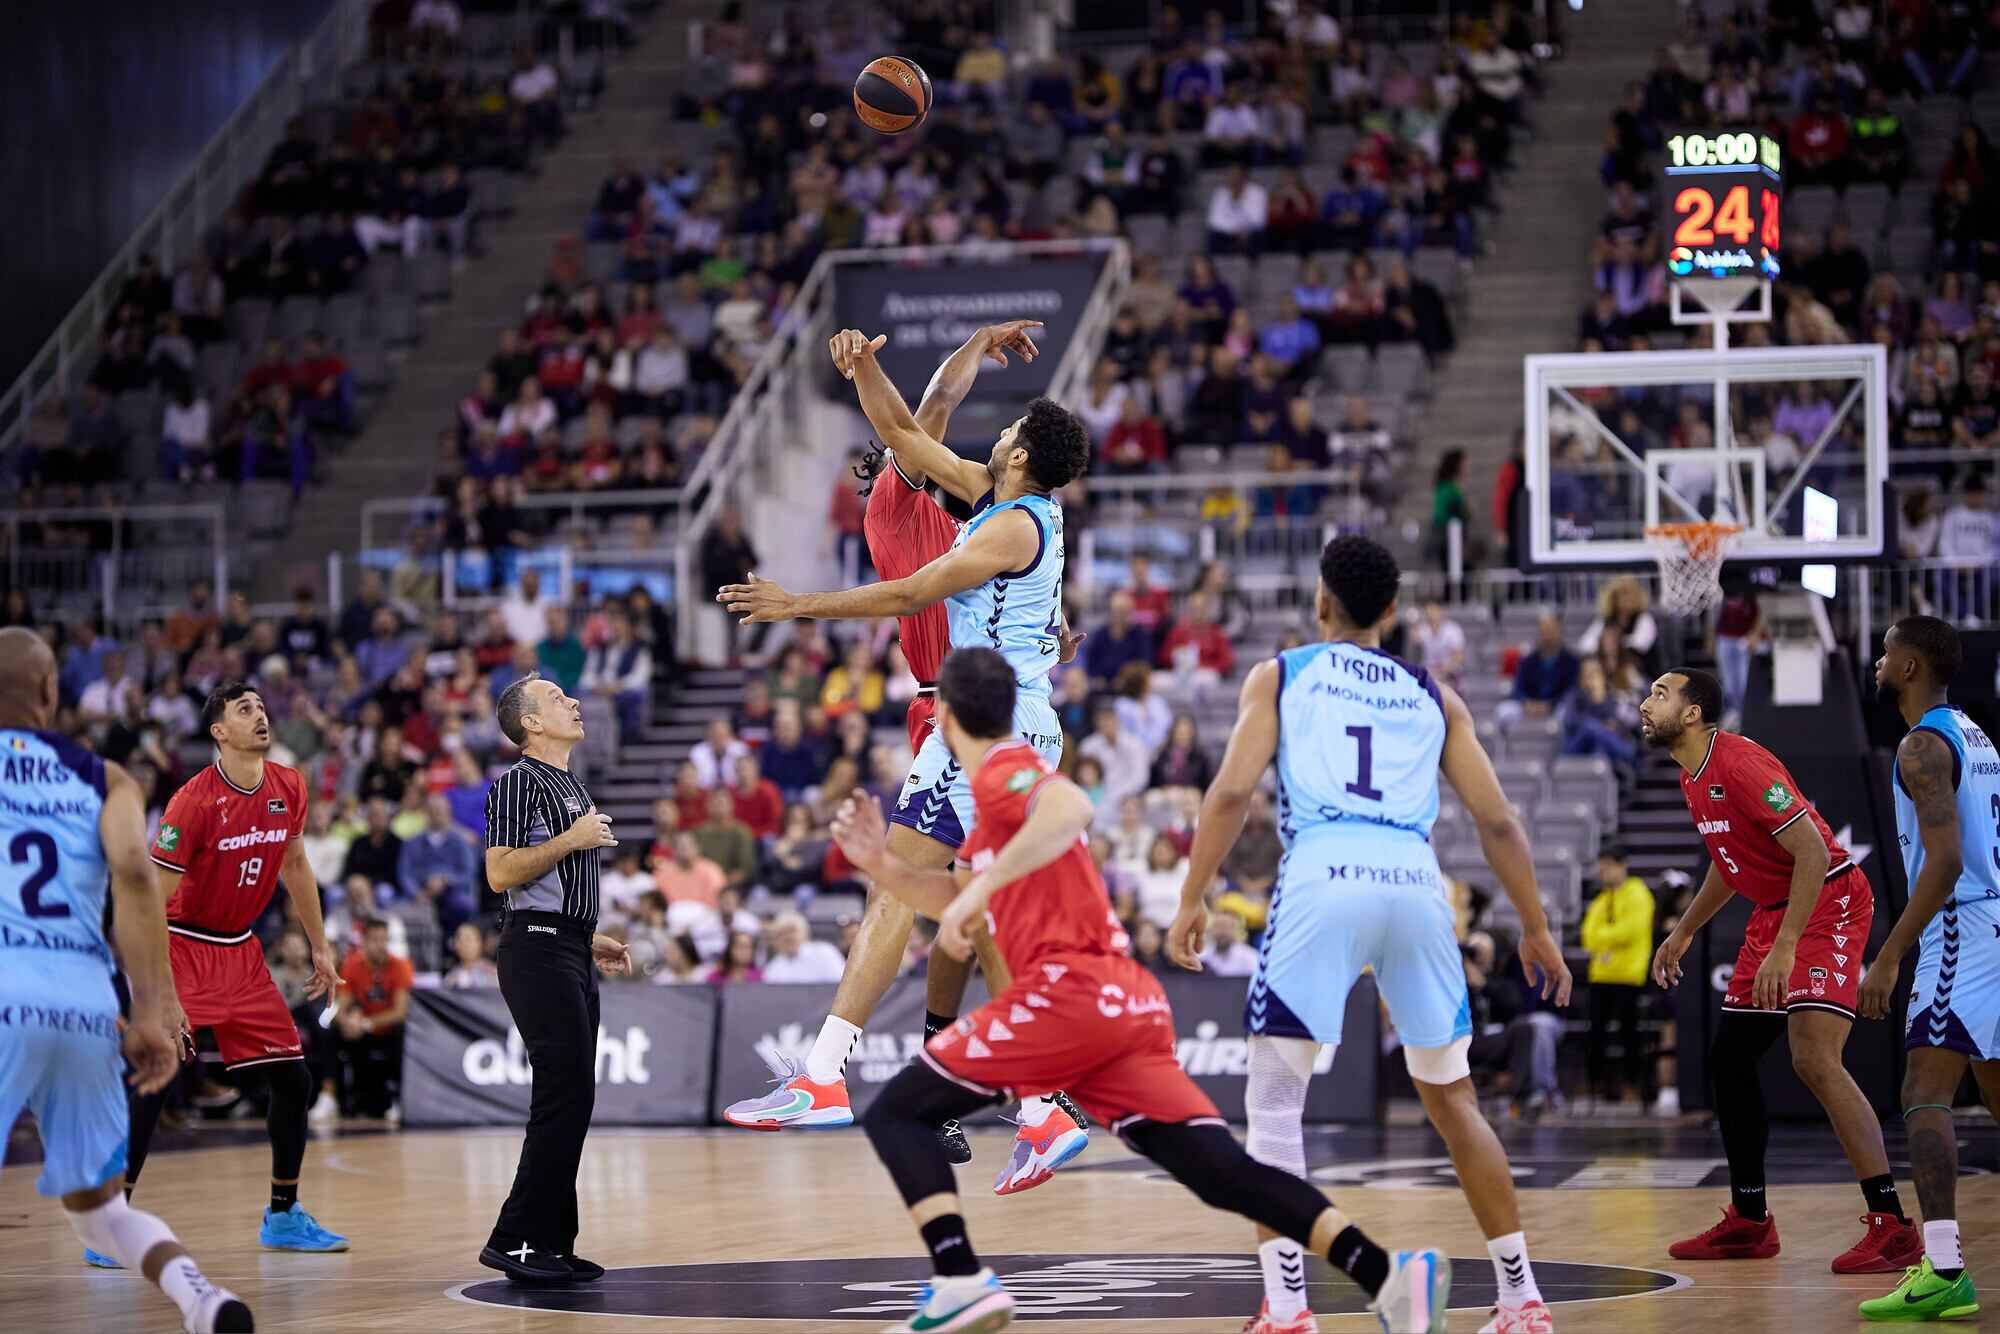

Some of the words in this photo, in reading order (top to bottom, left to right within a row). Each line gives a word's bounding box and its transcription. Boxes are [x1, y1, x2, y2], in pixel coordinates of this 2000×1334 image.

[1667, 133, 1757, 166] 10:00
[1674, 185, 1755, 246] 24
[1329, 653, 1396, 683] TYSON
[1345, 726, 1383, 802] 1
[9, 831, 70, 918] 2
[237, 857, 263, 888] 19
[1718, 846, 1739, 874] 5
[528, 925, 557, 935] SPALDING
